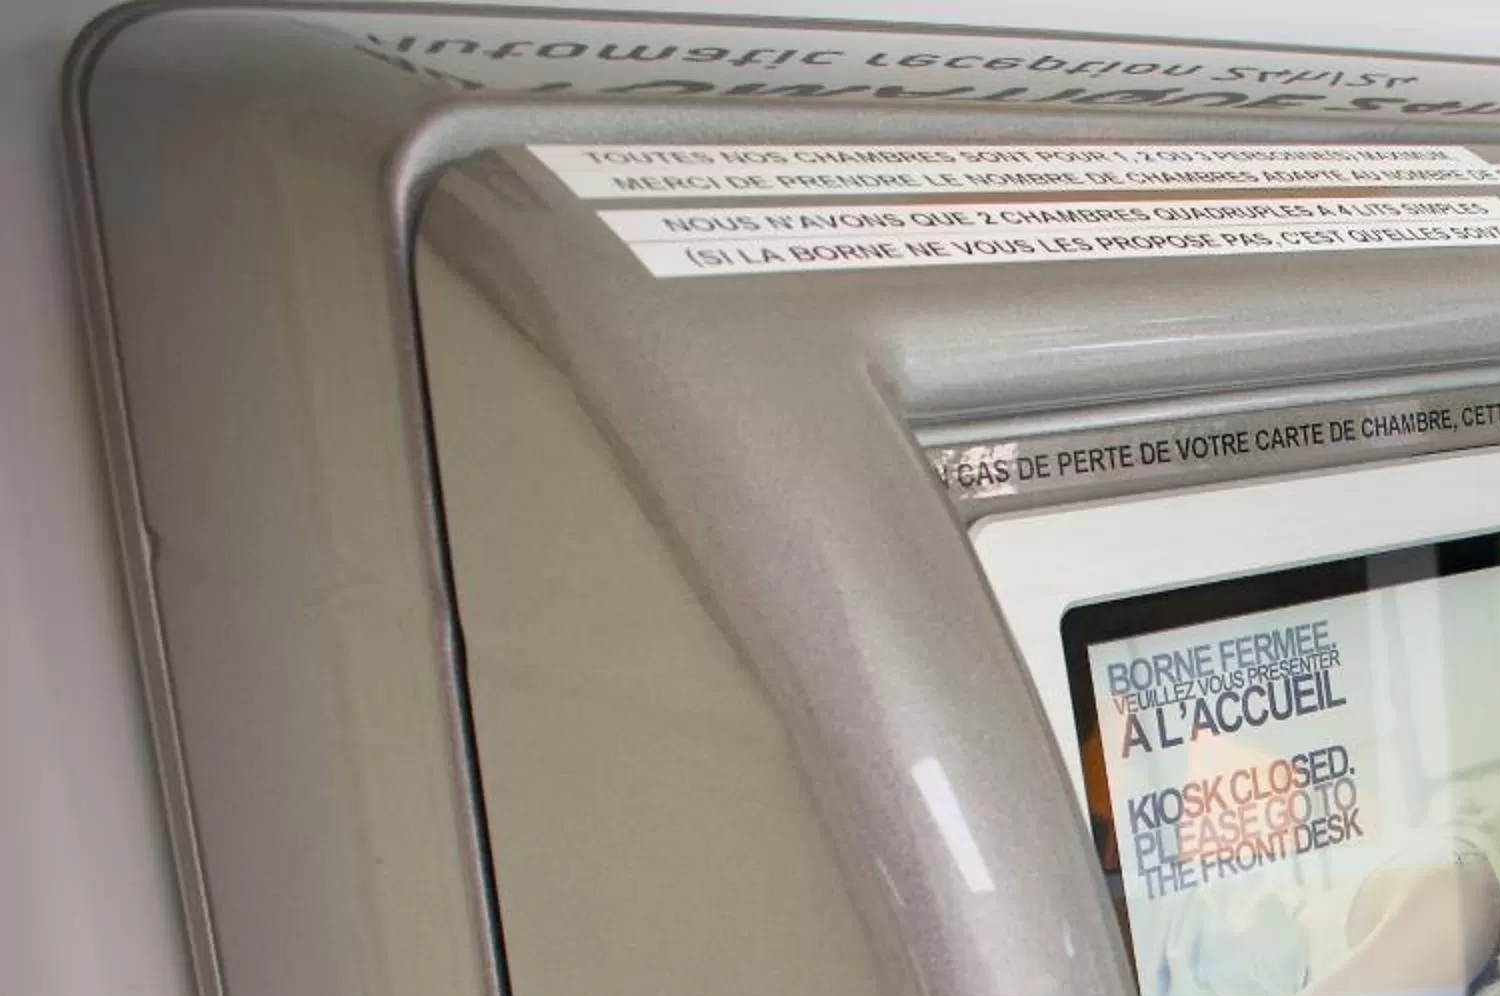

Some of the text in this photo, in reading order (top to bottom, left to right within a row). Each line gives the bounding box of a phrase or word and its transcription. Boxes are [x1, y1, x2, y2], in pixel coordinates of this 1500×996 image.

[584, 150, 716, 165] TOUTES
[719, 150, 788, 165] NOS
[793, 150, 957, 164] CHAMBRES
[959, 150, 1033, 164] SONT
[1036, 150, 1113, 163] POUR
[1156, 150, 1193, 162] OU
[612, 175, 722, 192] MERCI
[725, 174, 773, 191] DE
[775, 173, 923, 190] PRENDRE
[923, 173, 963, 188] LE
[963, 173, 1085, 187] NOMBRE
[1085, 172, 1125, 185] DE
[1126, 171, 1260, 184] CHAMBRES
[1262, 170, 1350, 182] ADAPTE
[1350, 170, 1382, 181] AU
[1382, 170, 1469, 181] NOMBRE
[661, 214, 762, 233] NOUS
[764, 212, 906, 232] N'AVONS
[910, 209, 976, 228] QUE
[976, 210, 999, 226] 2
[1000, 207, 1152, 226] CHAMBRES
[1153, 204, 1314, 223] QUADRUPLES
[1337, 203, 1354, 218] 4
[1355, 202, 1401, 218] LITS
[1401, 201, 1490, 217] SIMPLES
[685, 246, 734, 267] (SI
[737, 246, 785, 266] LA
[787, 242, 906, 264] BORNE
[905, 239, 953, 259] NE
[953, 236, 1037, 258] VOUS
[1036, 235, 1093, 254] LES
[1095, 232, 1223, 253] PROPOSE
[1222, 231, 1283, 250] PAS,
[1280, 229, 1347, 247] C'EST
[1347, 227, 1451, 245] QU'ELLES
[956, 459, 1010, 488] CAS
[1017, 454, 1051, 481] DE
[1058, 444, 1134, 477] PERTE
[1140, 439, 1171, 466] DE
[1176, 432, 1250, 461] VOTRE
[1255, 421, 1325, 451] CARTE
[1329, 417, 1357, 443] DE
[1361, 408, 1459, 439] CHAMBRE,
[1106, 620, 1338, 696] BORNE FERMEE.
[1112, 649, 1342, 716] VEUILLEZ VOUS PRESENTER
[1121, 669, 1347, 759] A L'ACCUEIL
[1127, 744, 1356, 835] KIOSK CLOSED.
[1133, 776, 1358, 878] PLEASE GO TO
[1139, 807, 1364, 900] THE FRONT DESK
